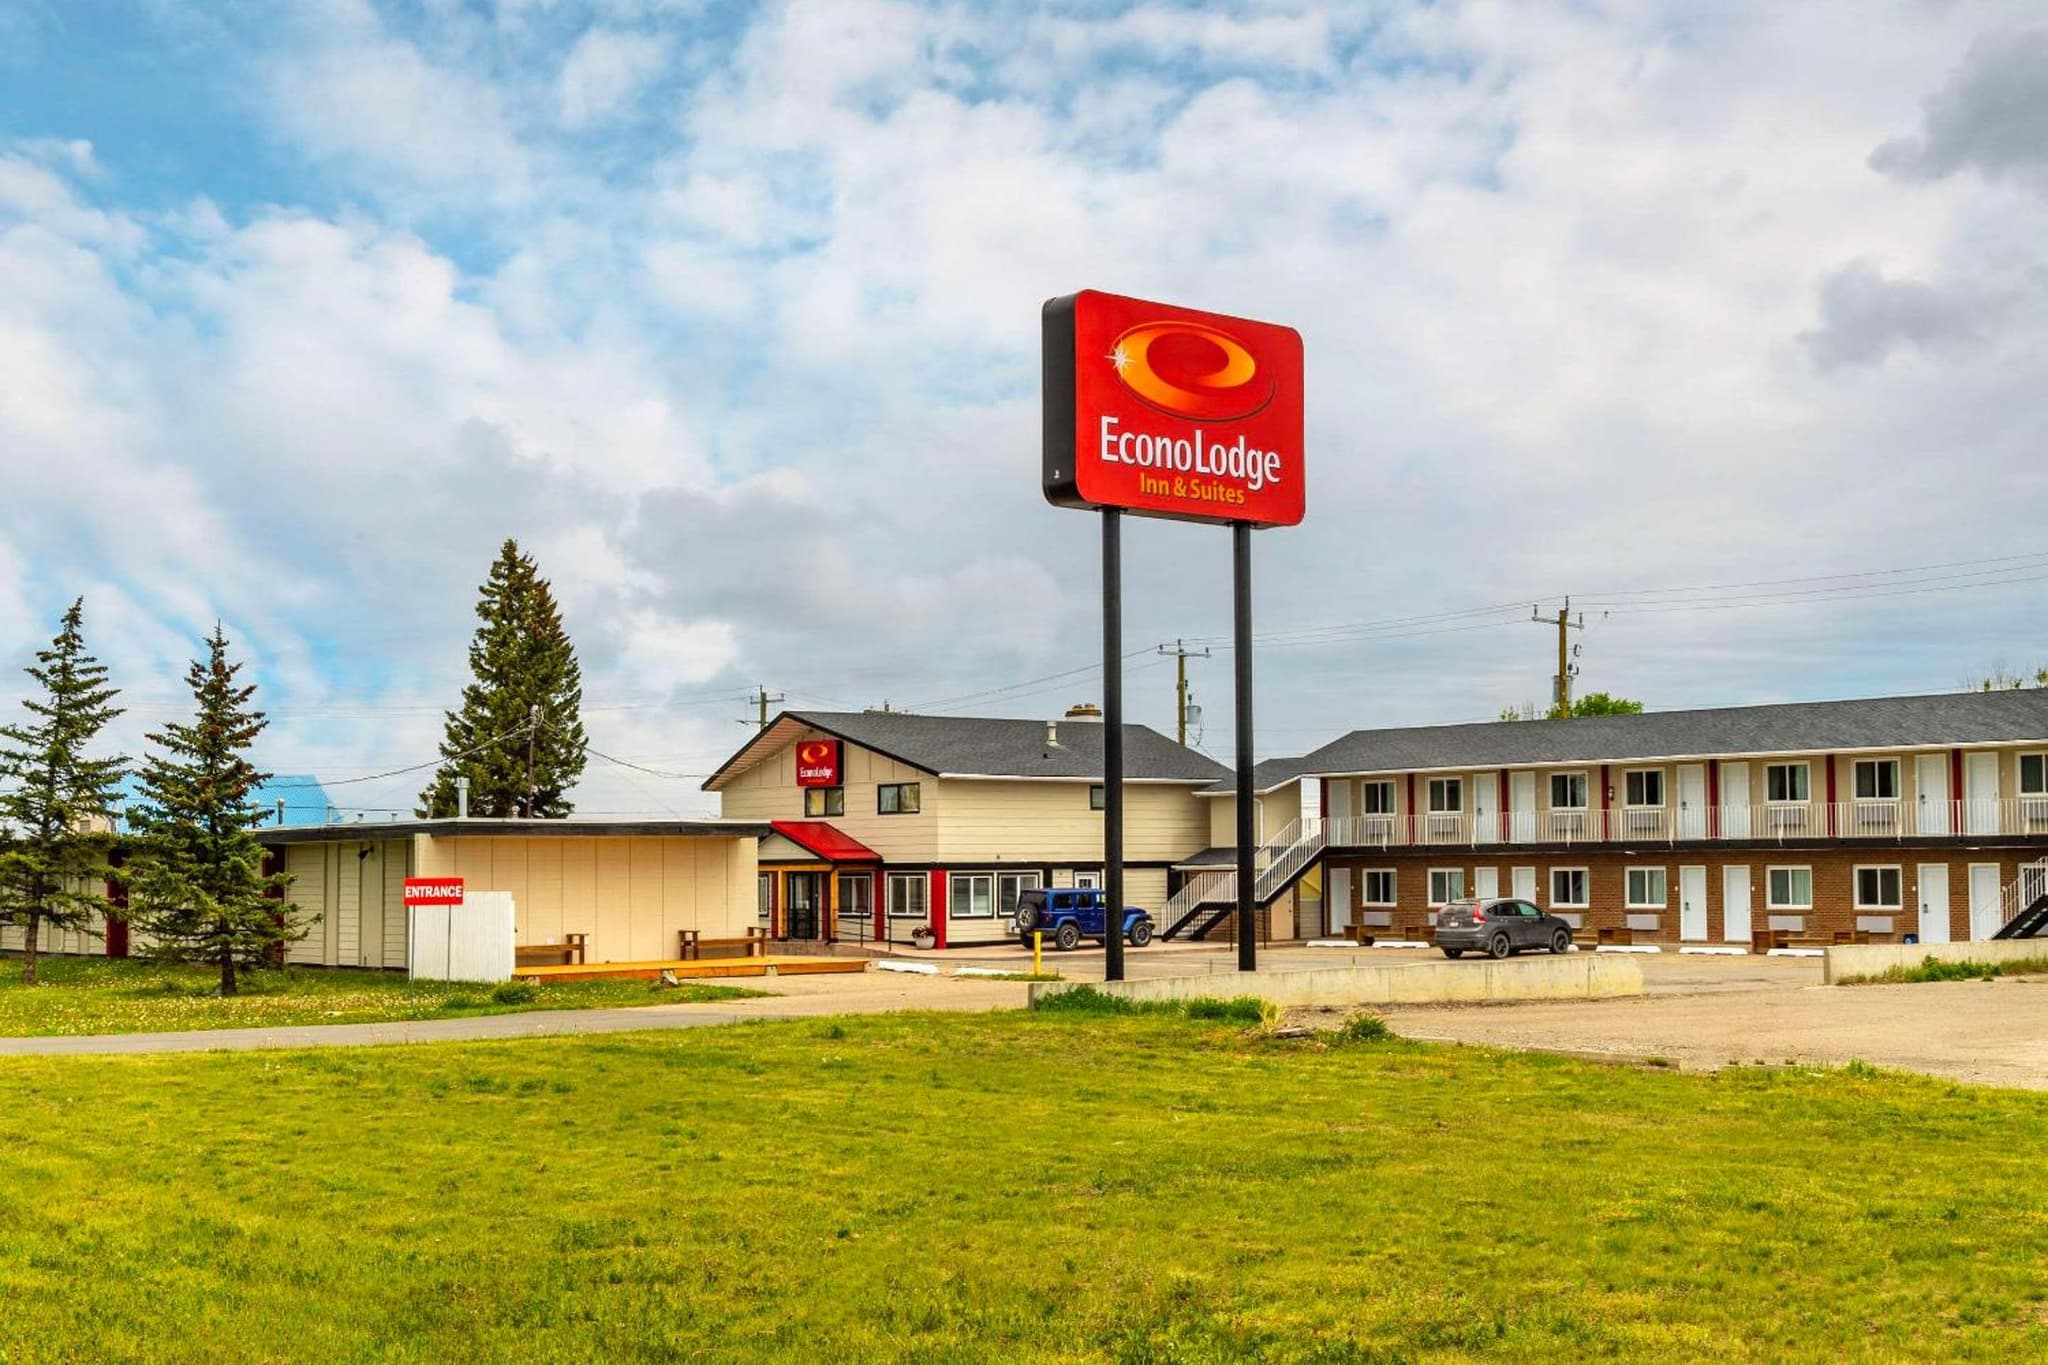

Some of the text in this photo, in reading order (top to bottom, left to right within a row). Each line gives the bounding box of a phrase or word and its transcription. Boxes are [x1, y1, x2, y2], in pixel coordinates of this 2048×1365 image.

[1101, 415, 1280, 491] EconoLodge
[1139, 472, 1245, 505] Inn & Suites
[404, 885, 463, 898] ENTRANCE
